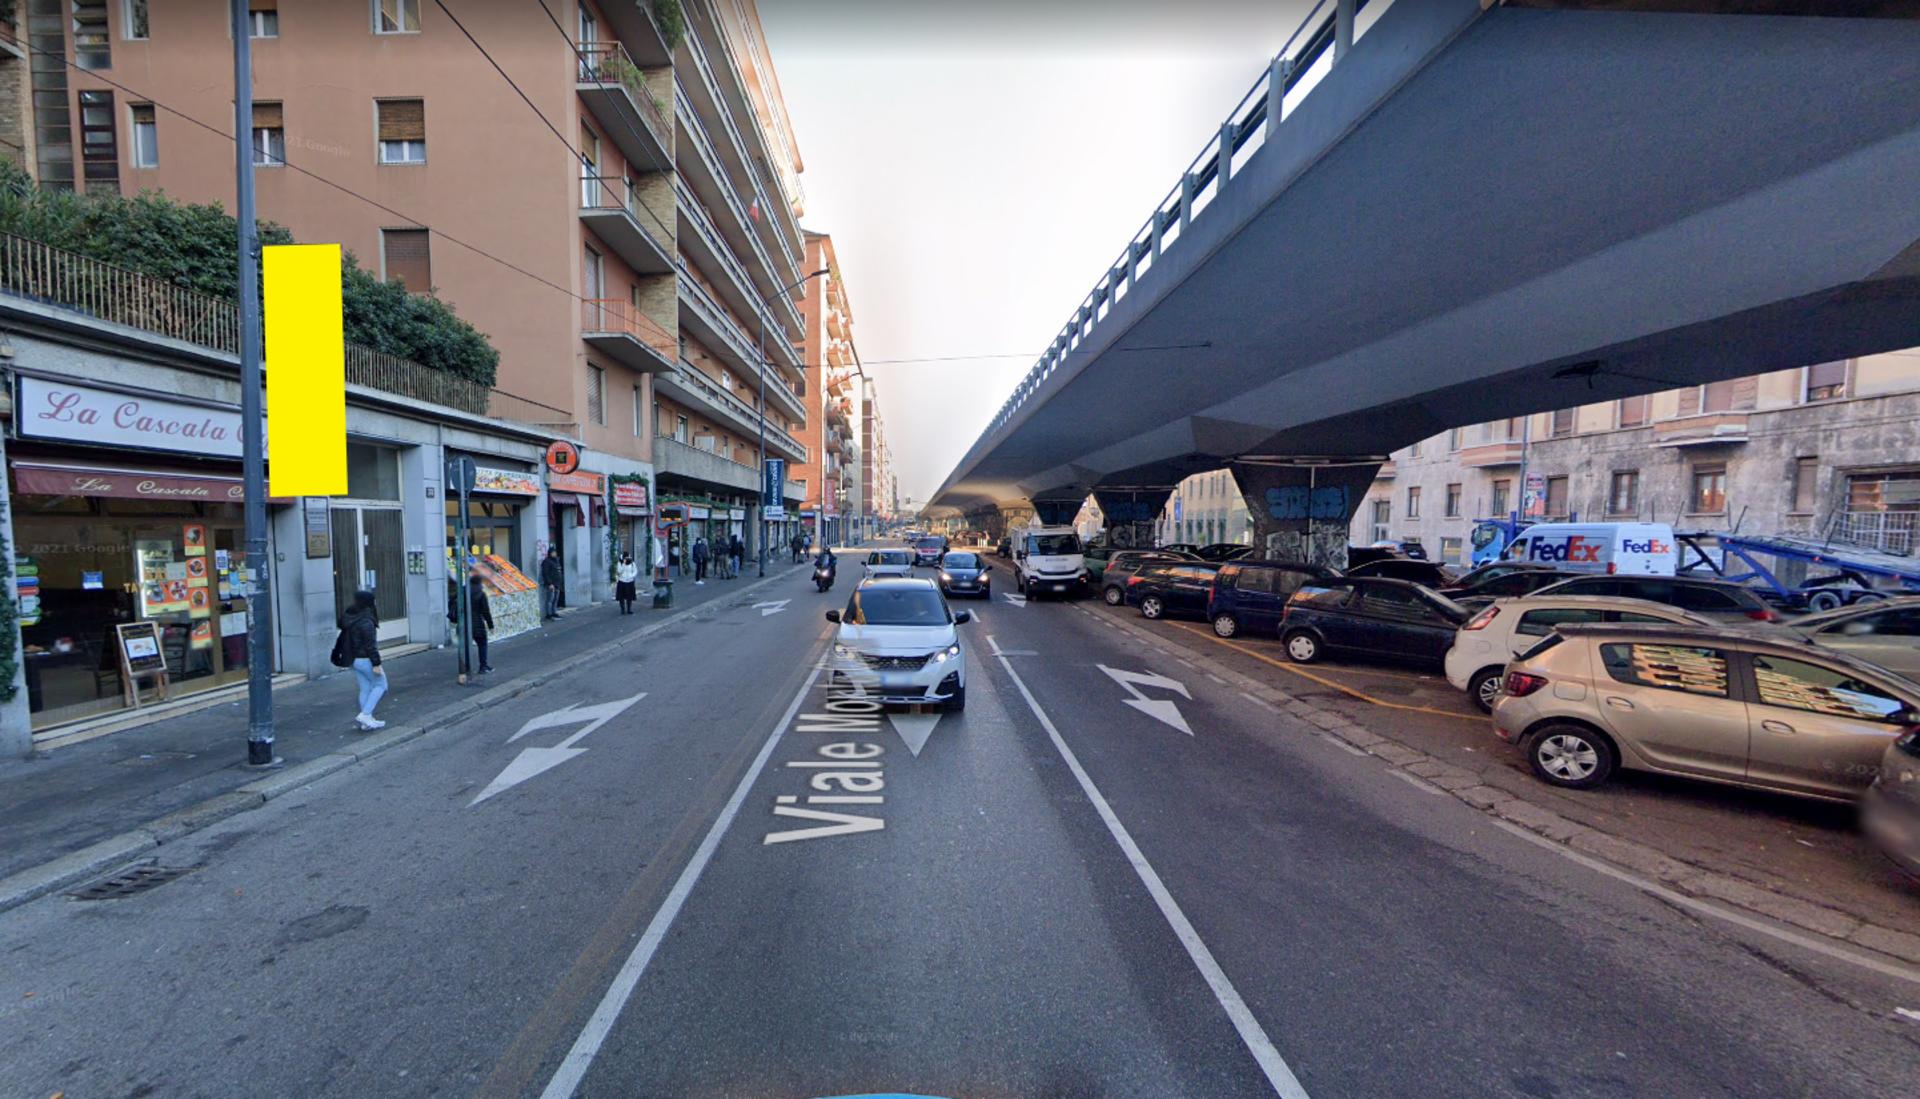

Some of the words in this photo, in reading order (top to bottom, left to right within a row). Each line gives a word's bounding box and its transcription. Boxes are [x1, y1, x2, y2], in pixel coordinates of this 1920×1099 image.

[38, 391, 100, 426] La
[71, 477, 113, 493] La
[136, 480, 209, 497] Cascata
[1529, 536, 1602, 563] FedEx
[1622, 539, 1670, 554] FedEx
